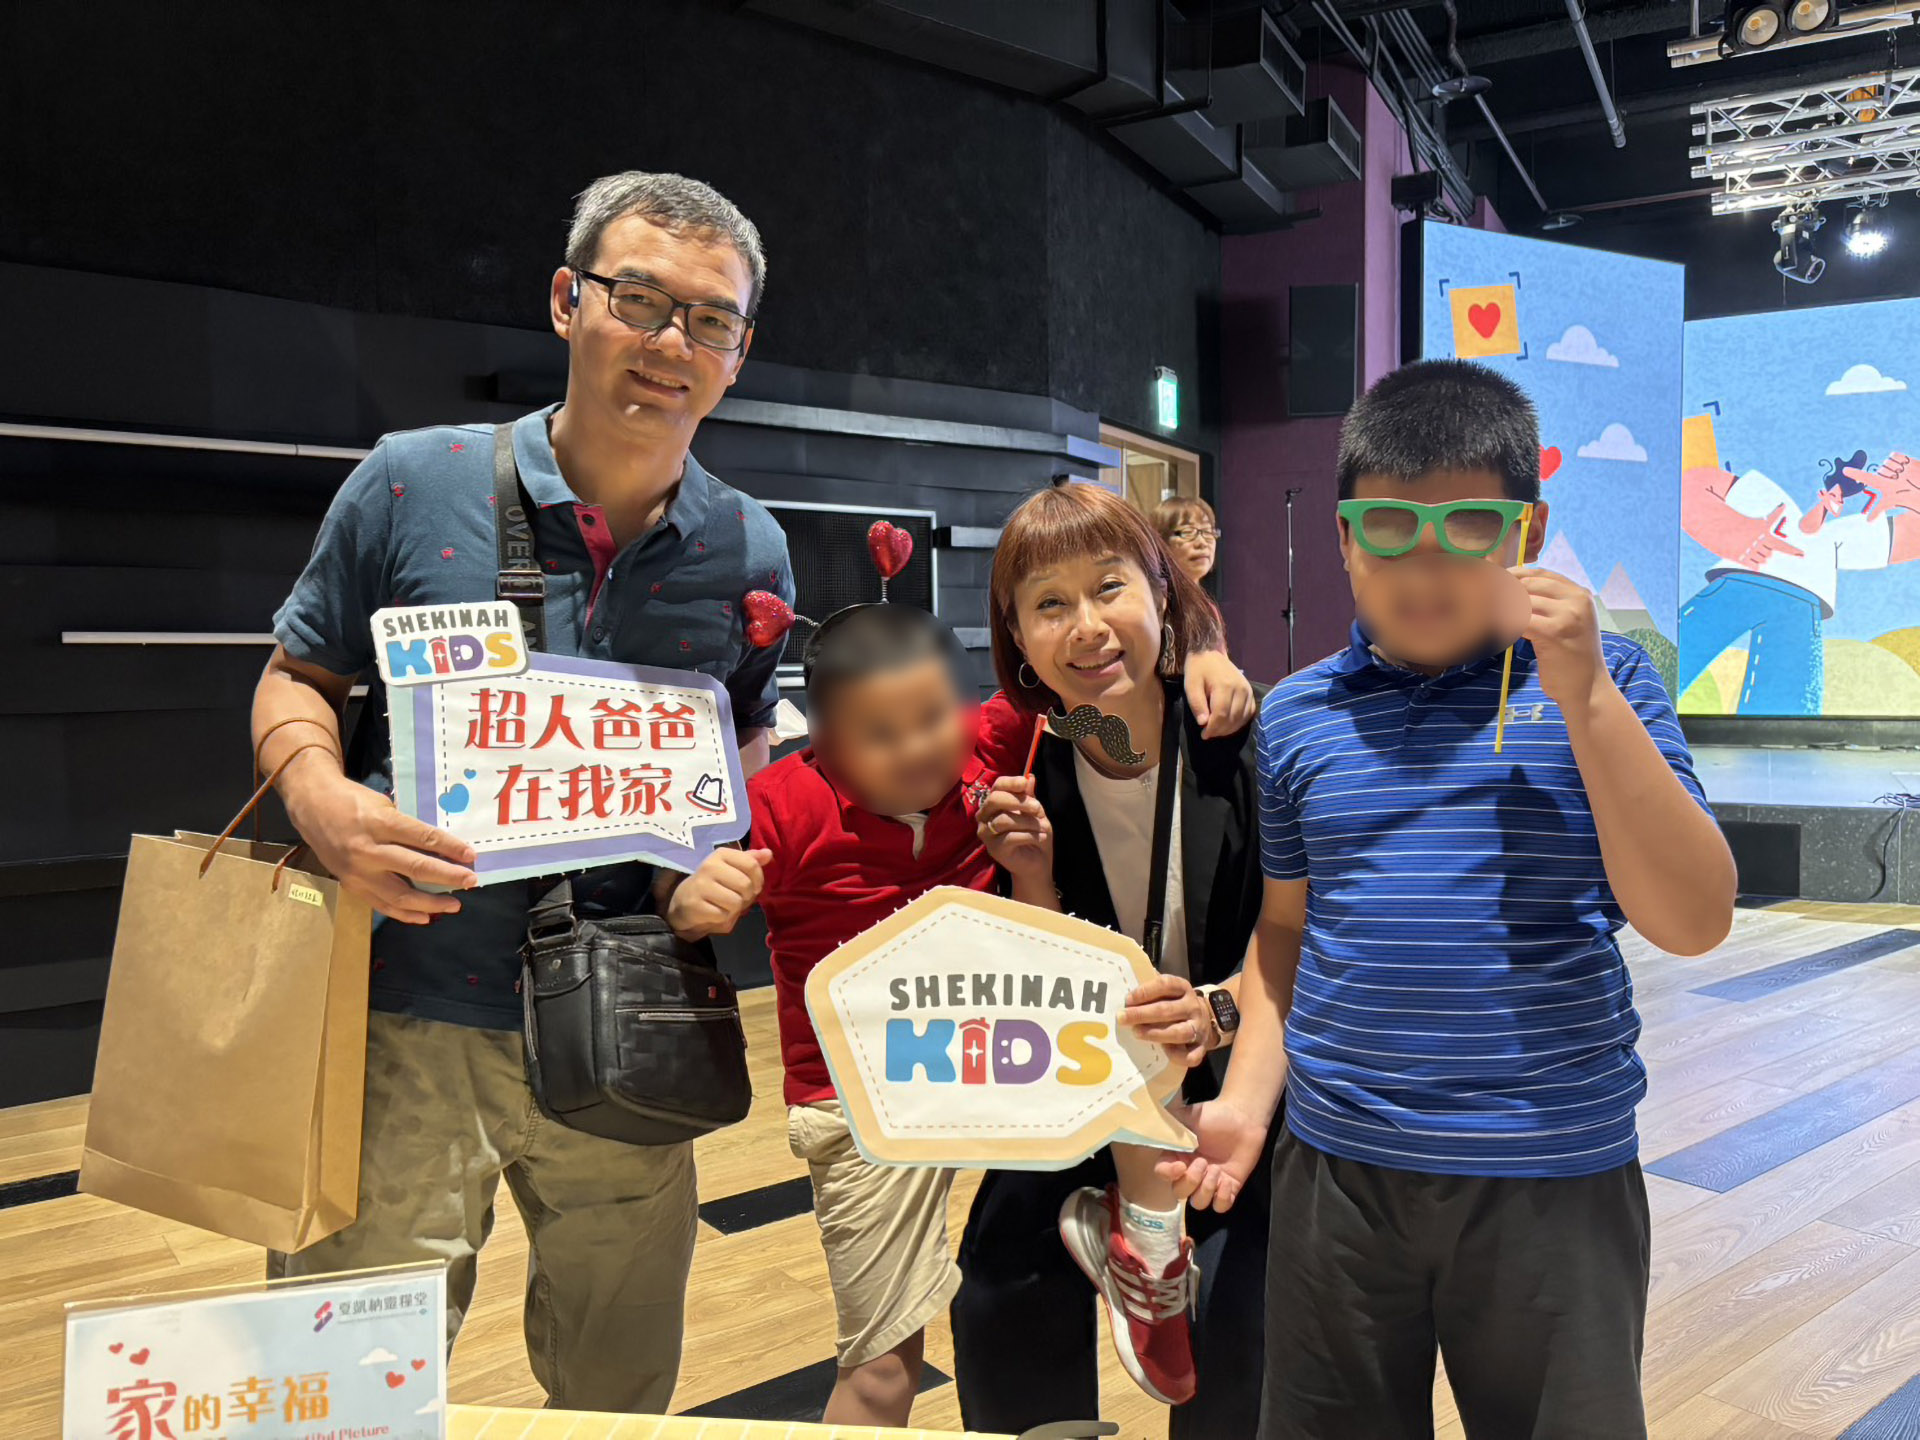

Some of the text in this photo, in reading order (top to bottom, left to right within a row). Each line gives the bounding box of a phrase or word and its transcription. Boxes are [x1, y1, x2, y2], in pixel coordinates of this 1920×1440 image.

[383, 608, 509, 638] SHEKINAH
[385, 631, 518, 678] KIDS
[464, 687, 697, 751] 超人爸爸
[493, 762, 673, 826] 在我家
[889, 973, 1108, 1014] SHEKINAH
[885, 1016, 1113, 1086] KIDS
[105, 1371, 330, 1440] 家的幸福
[339, 1424, 389, 1440] Picture
